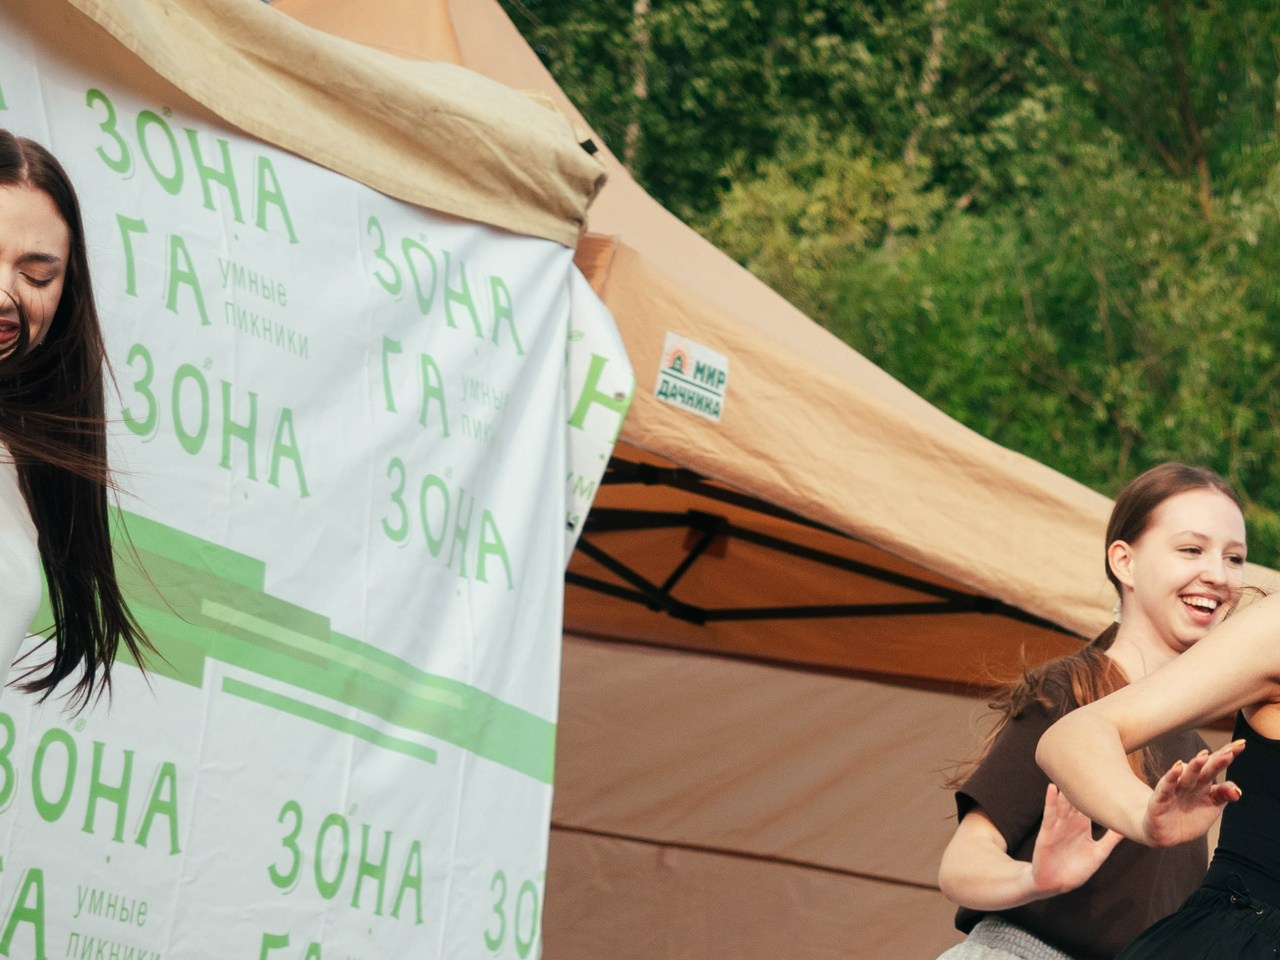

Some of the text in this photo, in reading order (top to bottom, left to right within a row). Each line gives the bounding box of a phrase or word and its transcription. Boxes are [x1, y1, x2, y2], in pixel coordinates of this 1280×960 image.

[86, 88, 300, 245] ЗОНА
[115, 213, 212, 326] ГА
[217, 258, 287, 307] умные
[367, 215, 526, 357] ЗОНА
[225, 301, 309, 359] пикники
[693, 360, 726, 389] МИР
[121, 343, 311, 499] ЗОНА
[382, 334, 451, 438] ГА
[656, 379, 721, 417] ДАЧНИКА
[381, 456, 515, 591] ЗОНА
[73, 884, 149, 927] умные
[267, 800, 424, 926] ЗОНА
[483, 870, 540, 960] ЗО
